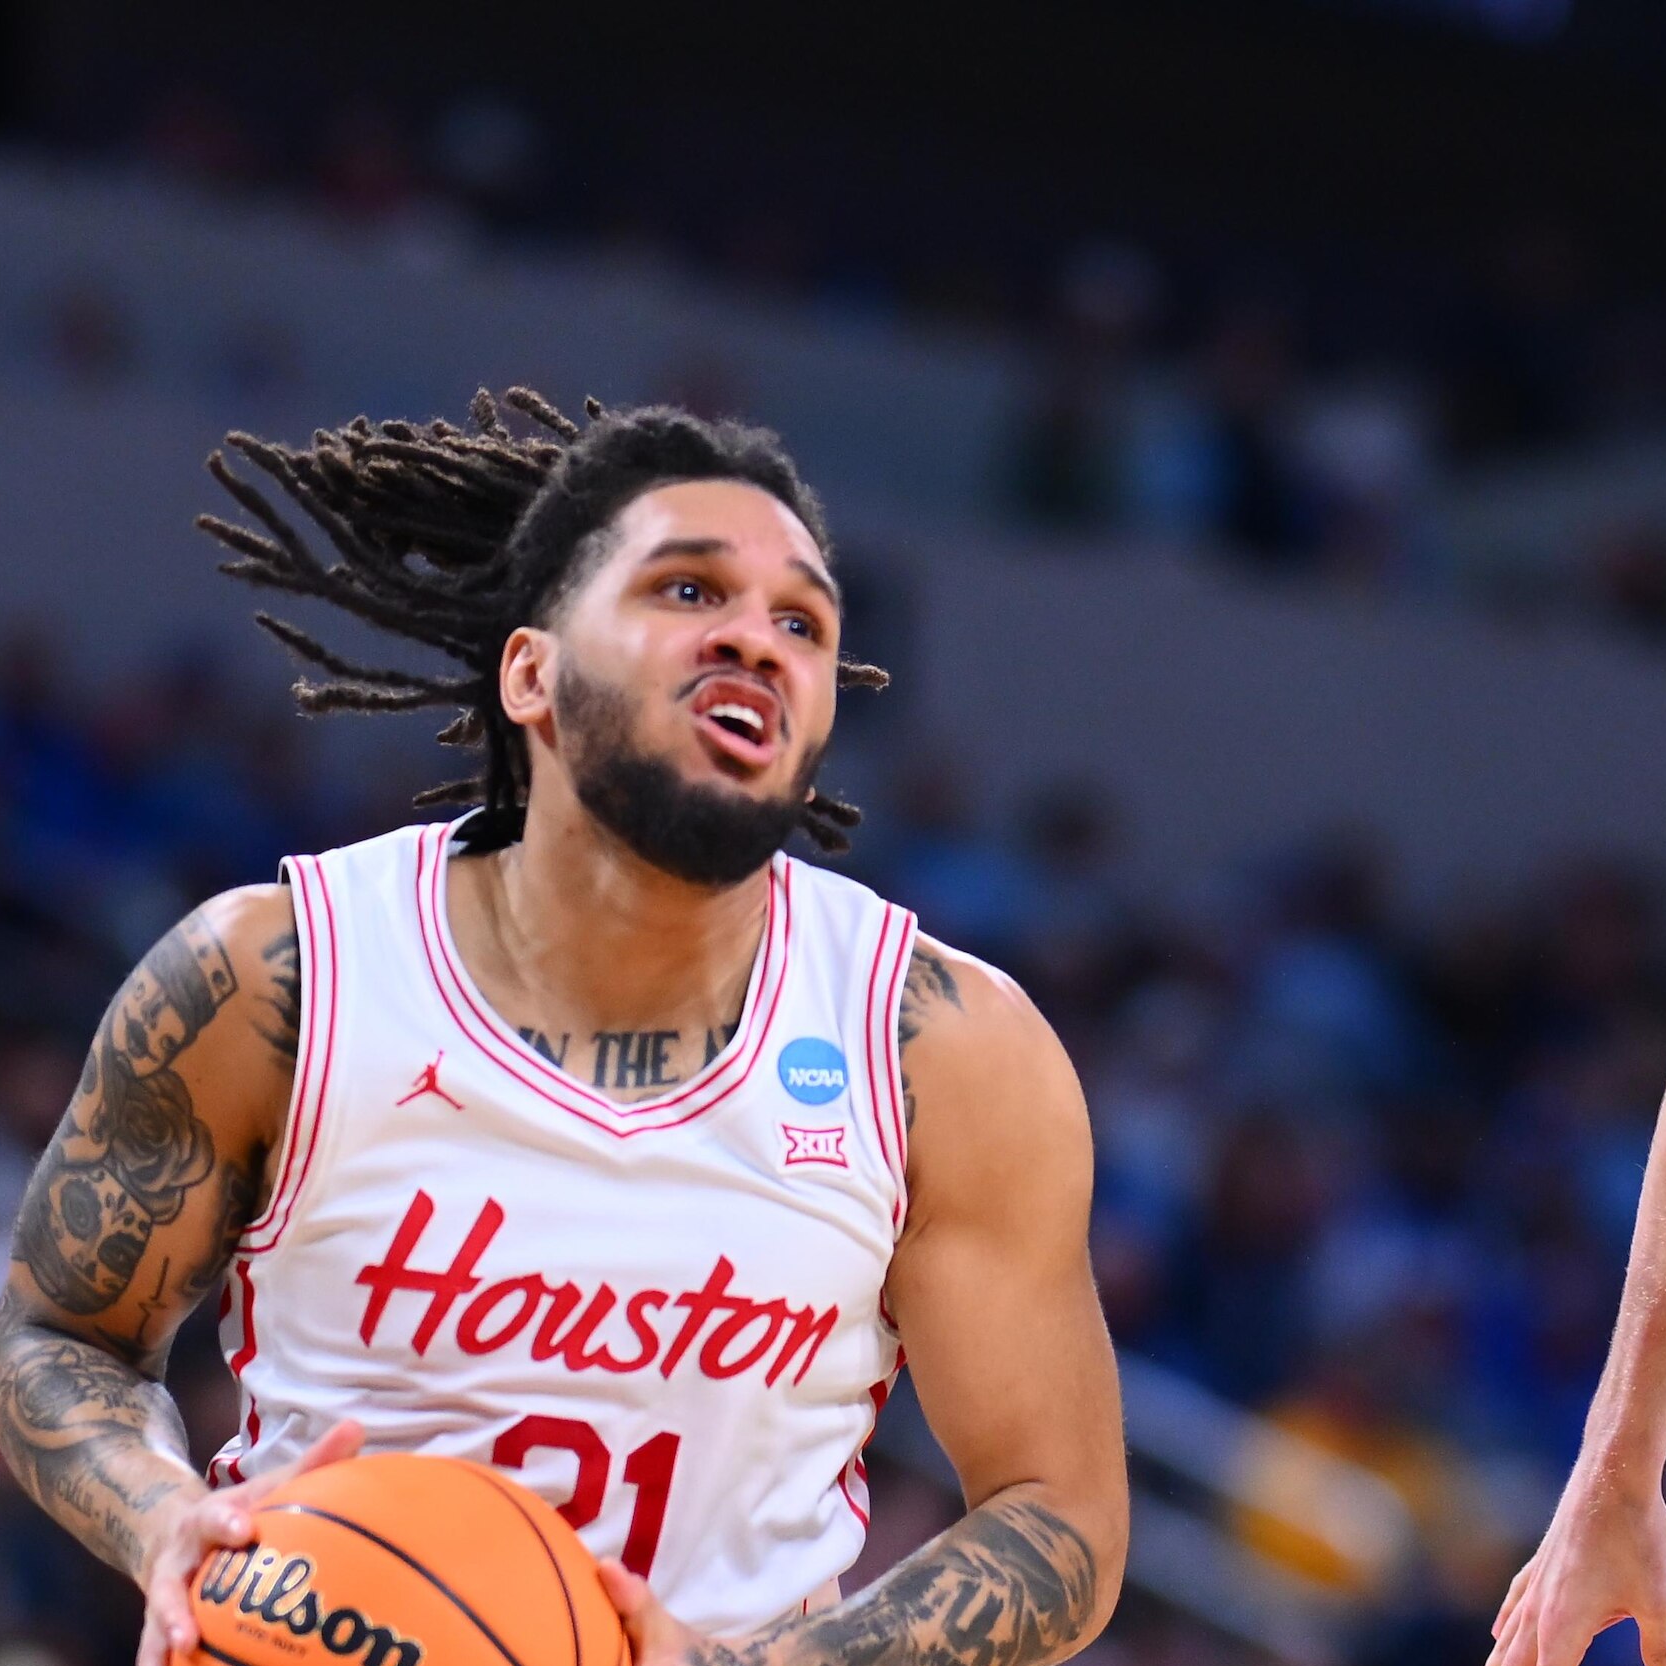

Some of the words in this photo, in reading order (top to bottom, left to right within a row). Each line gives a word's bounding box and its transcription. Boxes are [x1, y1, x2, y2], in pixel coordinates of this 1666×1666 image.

[591, 1029, 680, 1088] THE
[788, 1066, 845, 1088] NCAA
[354, 1188, 840, 1389] Houston
[492, 1414, 681, 1583] 21
